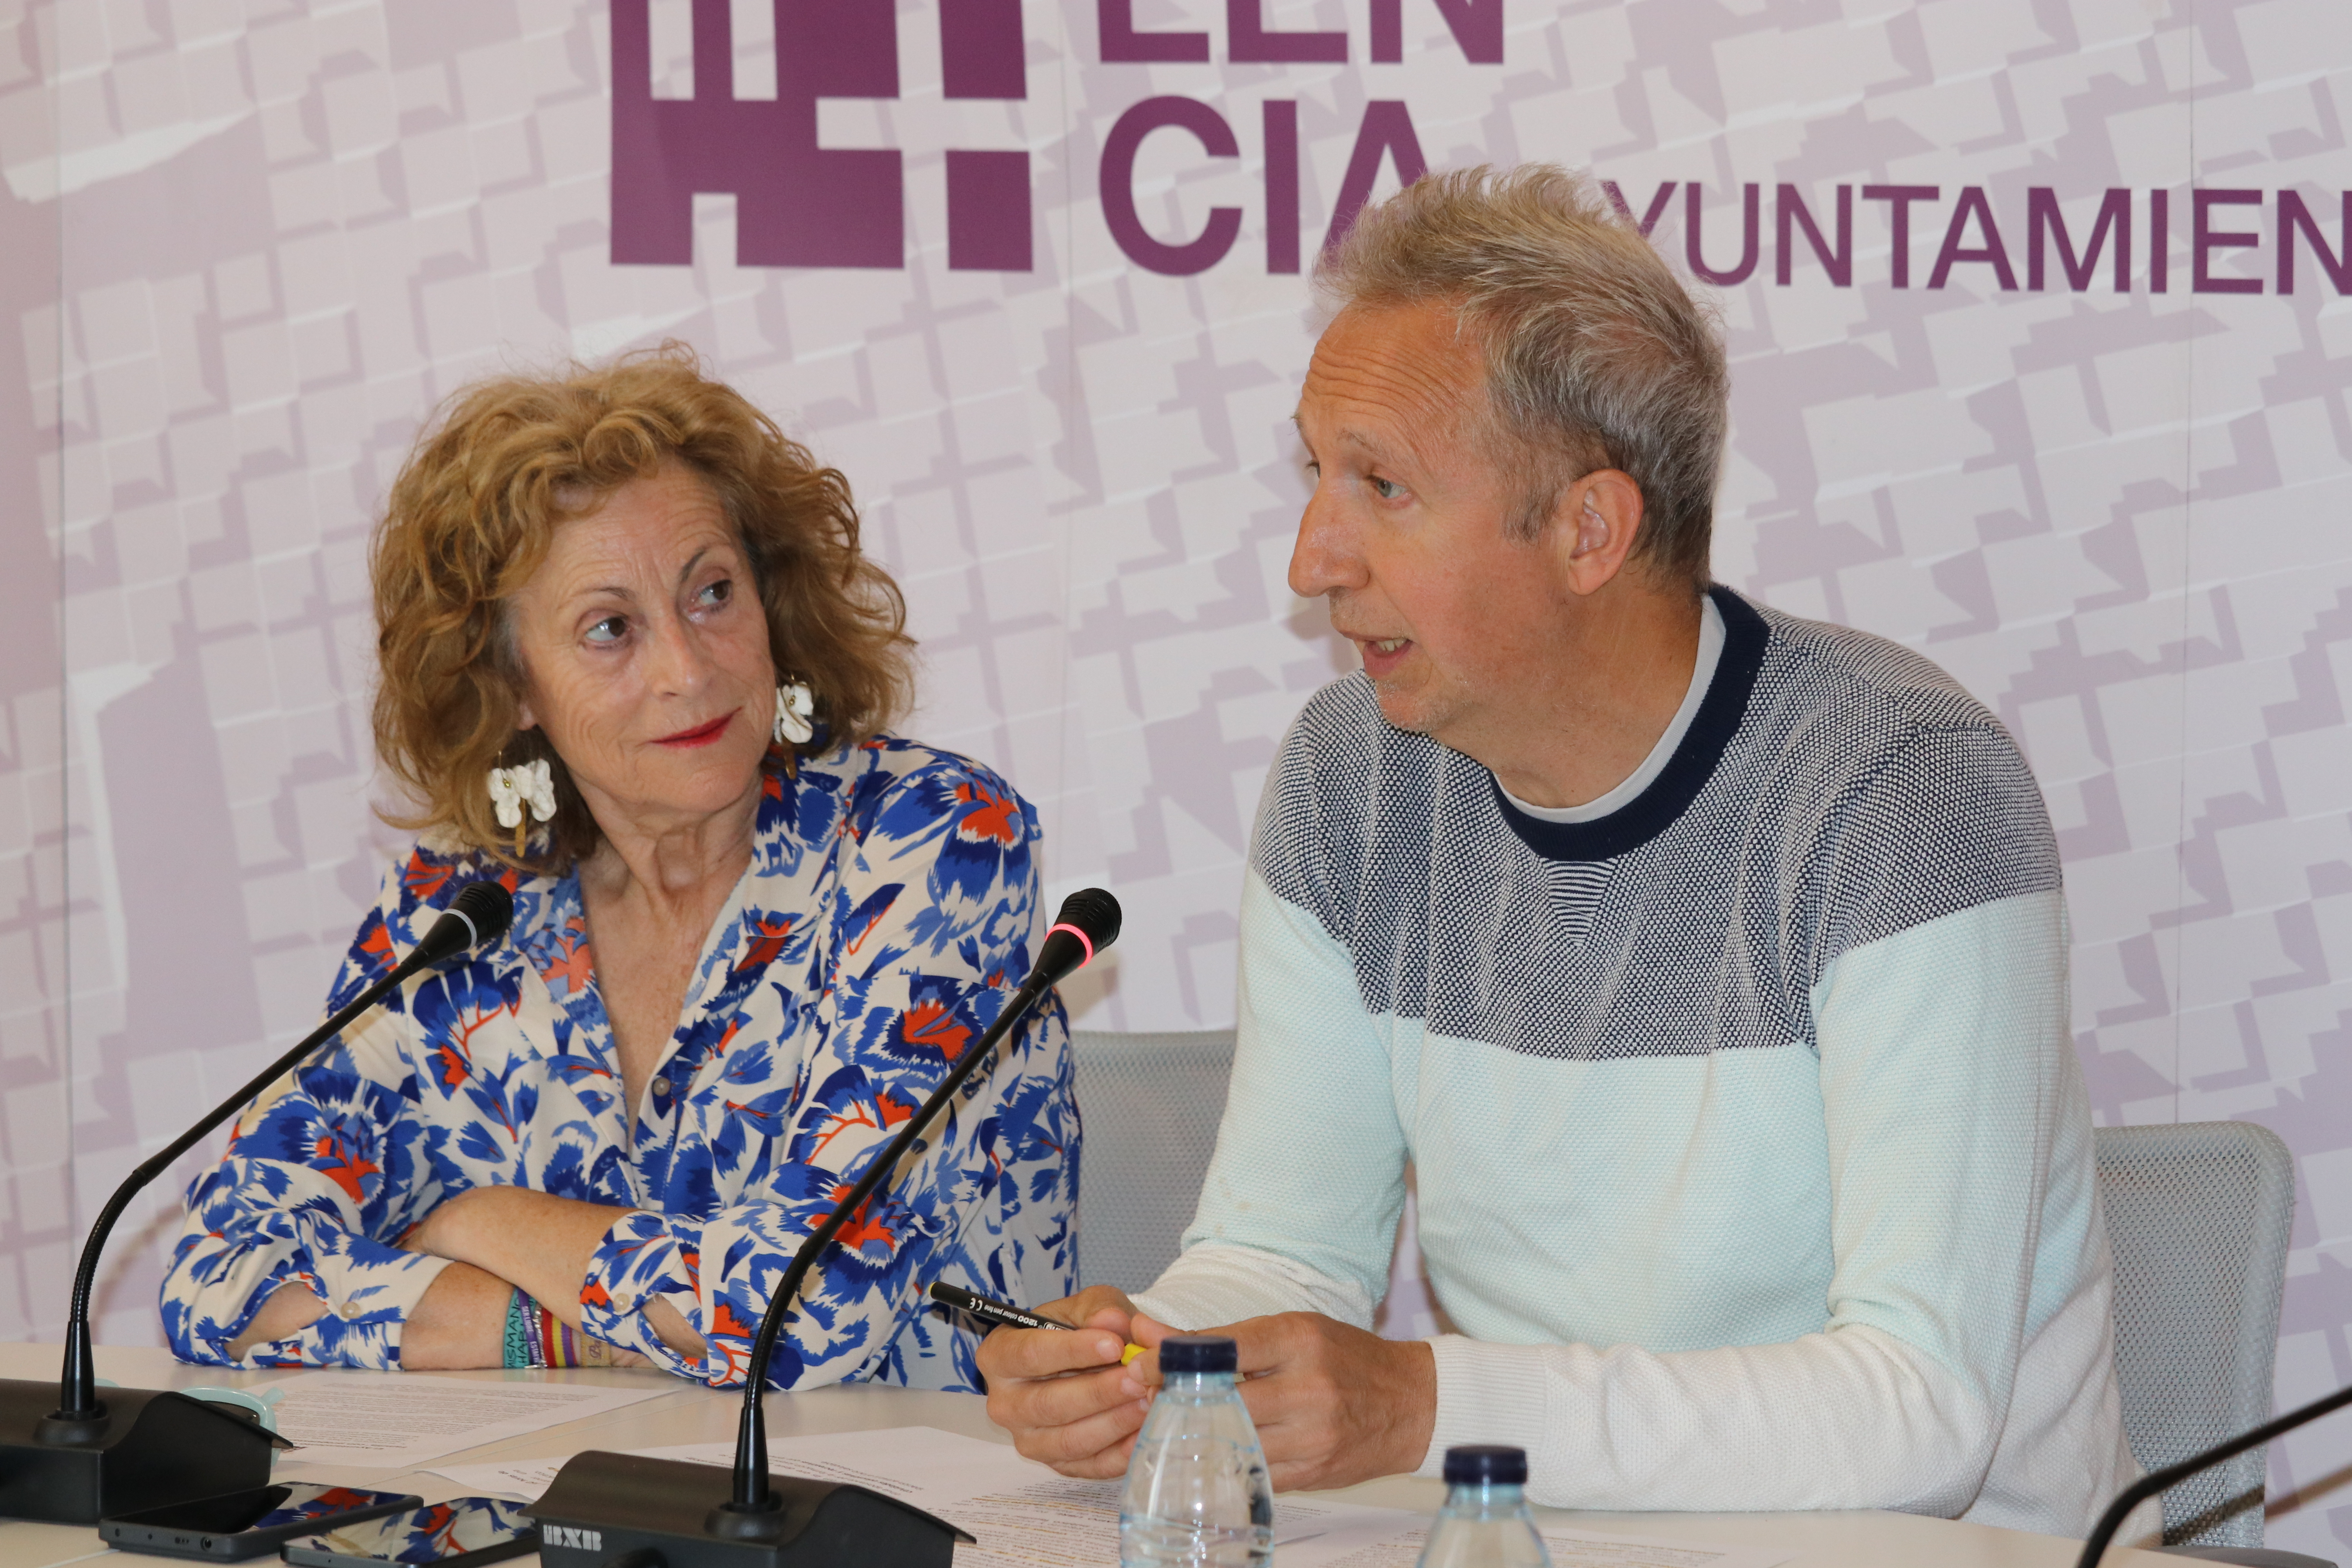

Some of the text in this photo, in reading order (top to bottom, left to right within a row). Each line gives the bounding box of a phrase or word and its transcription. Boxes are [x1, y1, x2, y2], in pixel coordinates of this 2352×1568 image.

[1599, 181, 2352, 297] YUNTAMIEN
[984, 1304, 993, 1313] fine
[993, 1307, 1004, 1315] pen
[1002, 1310, 1018, 1320] colour
[1018, 1315, 1038, 1327] 1200
